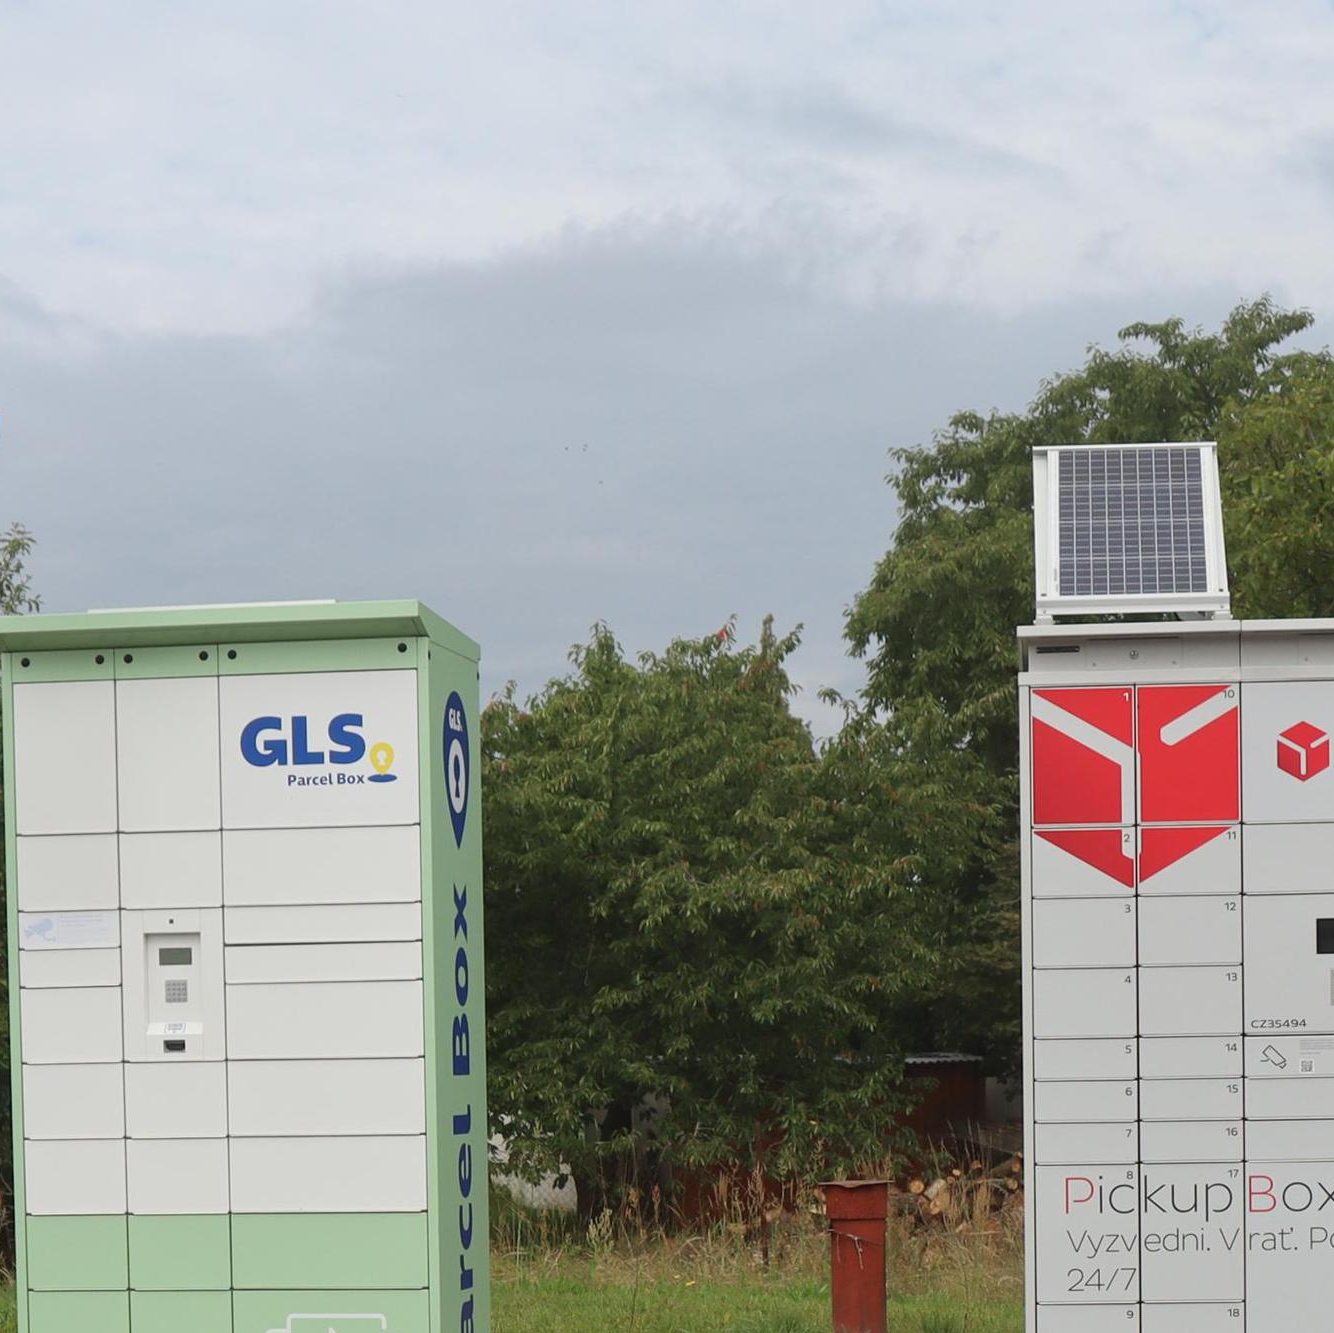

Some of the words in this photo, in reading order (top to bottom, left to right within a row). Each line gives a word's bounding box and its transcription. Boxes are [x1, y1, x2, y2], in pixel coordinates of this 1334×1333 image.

[1123, 691, 1131, 702] 1
[1223, 688, 1235, 699] 10
[239, 713, 366, 768] GLS
[287, 772, 333, 787] Parcel
[336, 772, 365, 785] Box
[1123, 833, 1131, 843] 2
[1225, 830, 1237, 841] 11
[1124, 904, 1132, 914] 3
[1224, 902, 1237, 913] 12
[452, 883, 471, 1076] Box
[1124, 974, 1132, 985] 4
[1225, 972, 1238, 983] 13
[1250, 1018, 1307, 1029] CZ35494
[1125, 1044, 1132, 1054] 5
[1225, 1043, 1238, 1053] 14
[1125, 1086, 1133, 1097] 6
[1226, 1084, 1239, 1095] 15
[1125, 1128, 1133, 1138] 7
[1226, 1127, 1239, 1137] 16
[1126, 1170, 1134, 1180] 8
[1227, 1168, 1240, 1178] 17
[1064, 1174, 1233, 1222] Pickup
[1066, 1227, 1211, 1259] Vyzvedni.
[1067, 1267, 1137, 1292] 24/7
[1126, 1309, 1134, 1320] 9
[1227, 1308, 1241, 1318] 18
